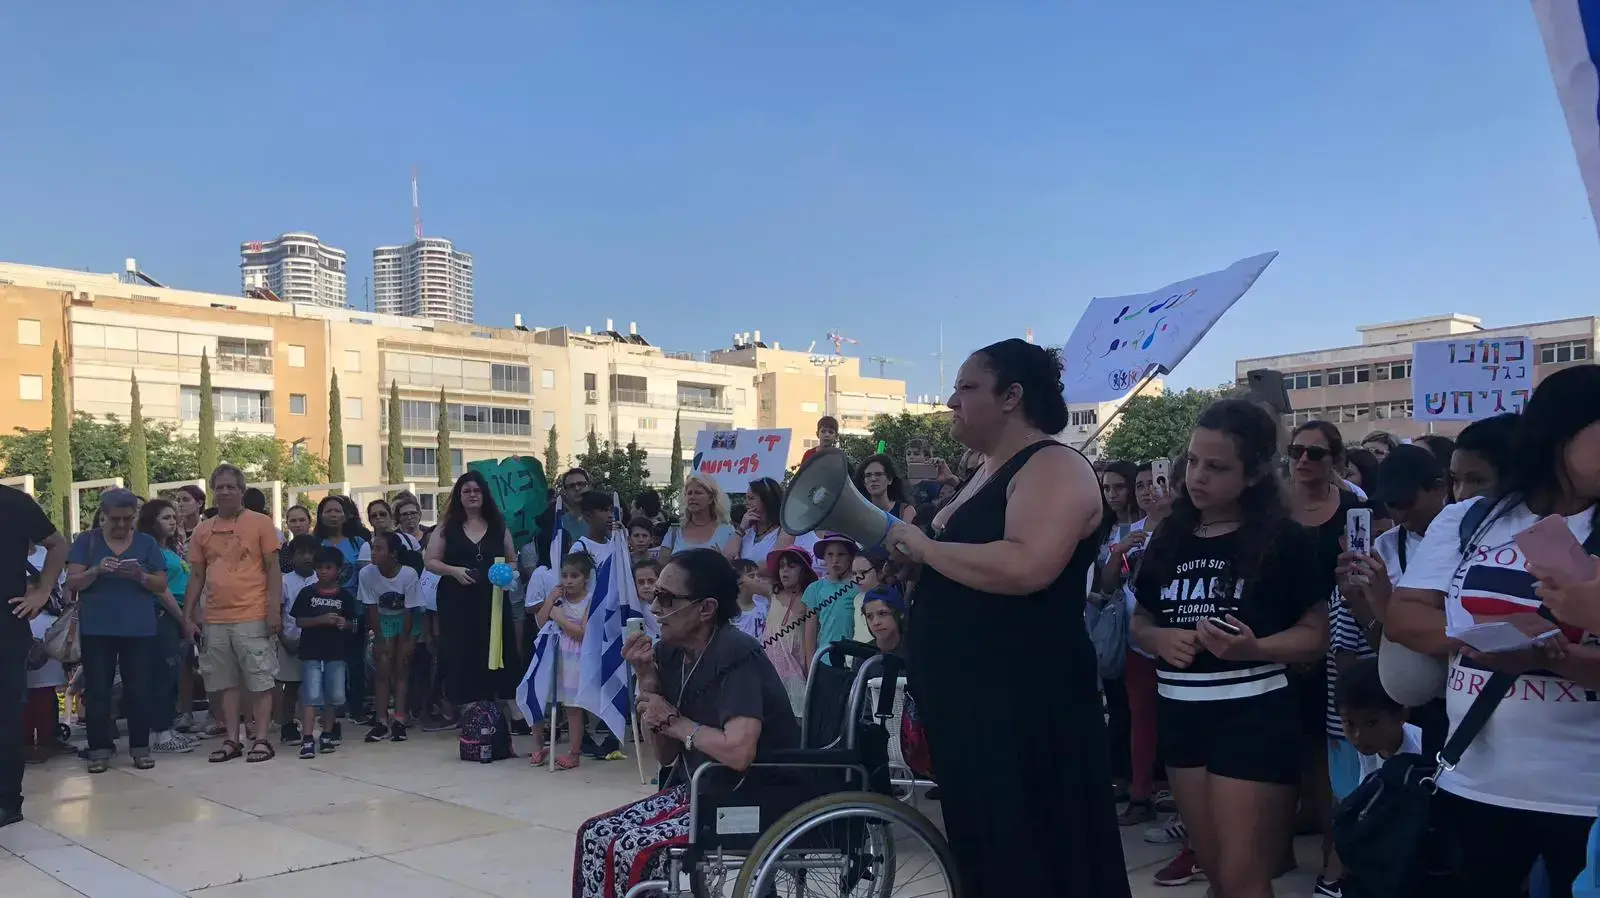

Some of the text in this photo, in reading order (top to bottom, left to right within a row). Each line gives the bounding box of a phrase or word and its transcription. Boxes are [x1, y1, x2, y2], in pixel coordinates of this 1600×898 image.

[1448, 339, 1524, 364] כולנו
[1481, 365, 1525, 381] נגד
[491, 470, 534, 511] כאן
[1176, 558, 1229, 574] SOUTH SID
[1177, 603, 1216, 614] FLORIDA
